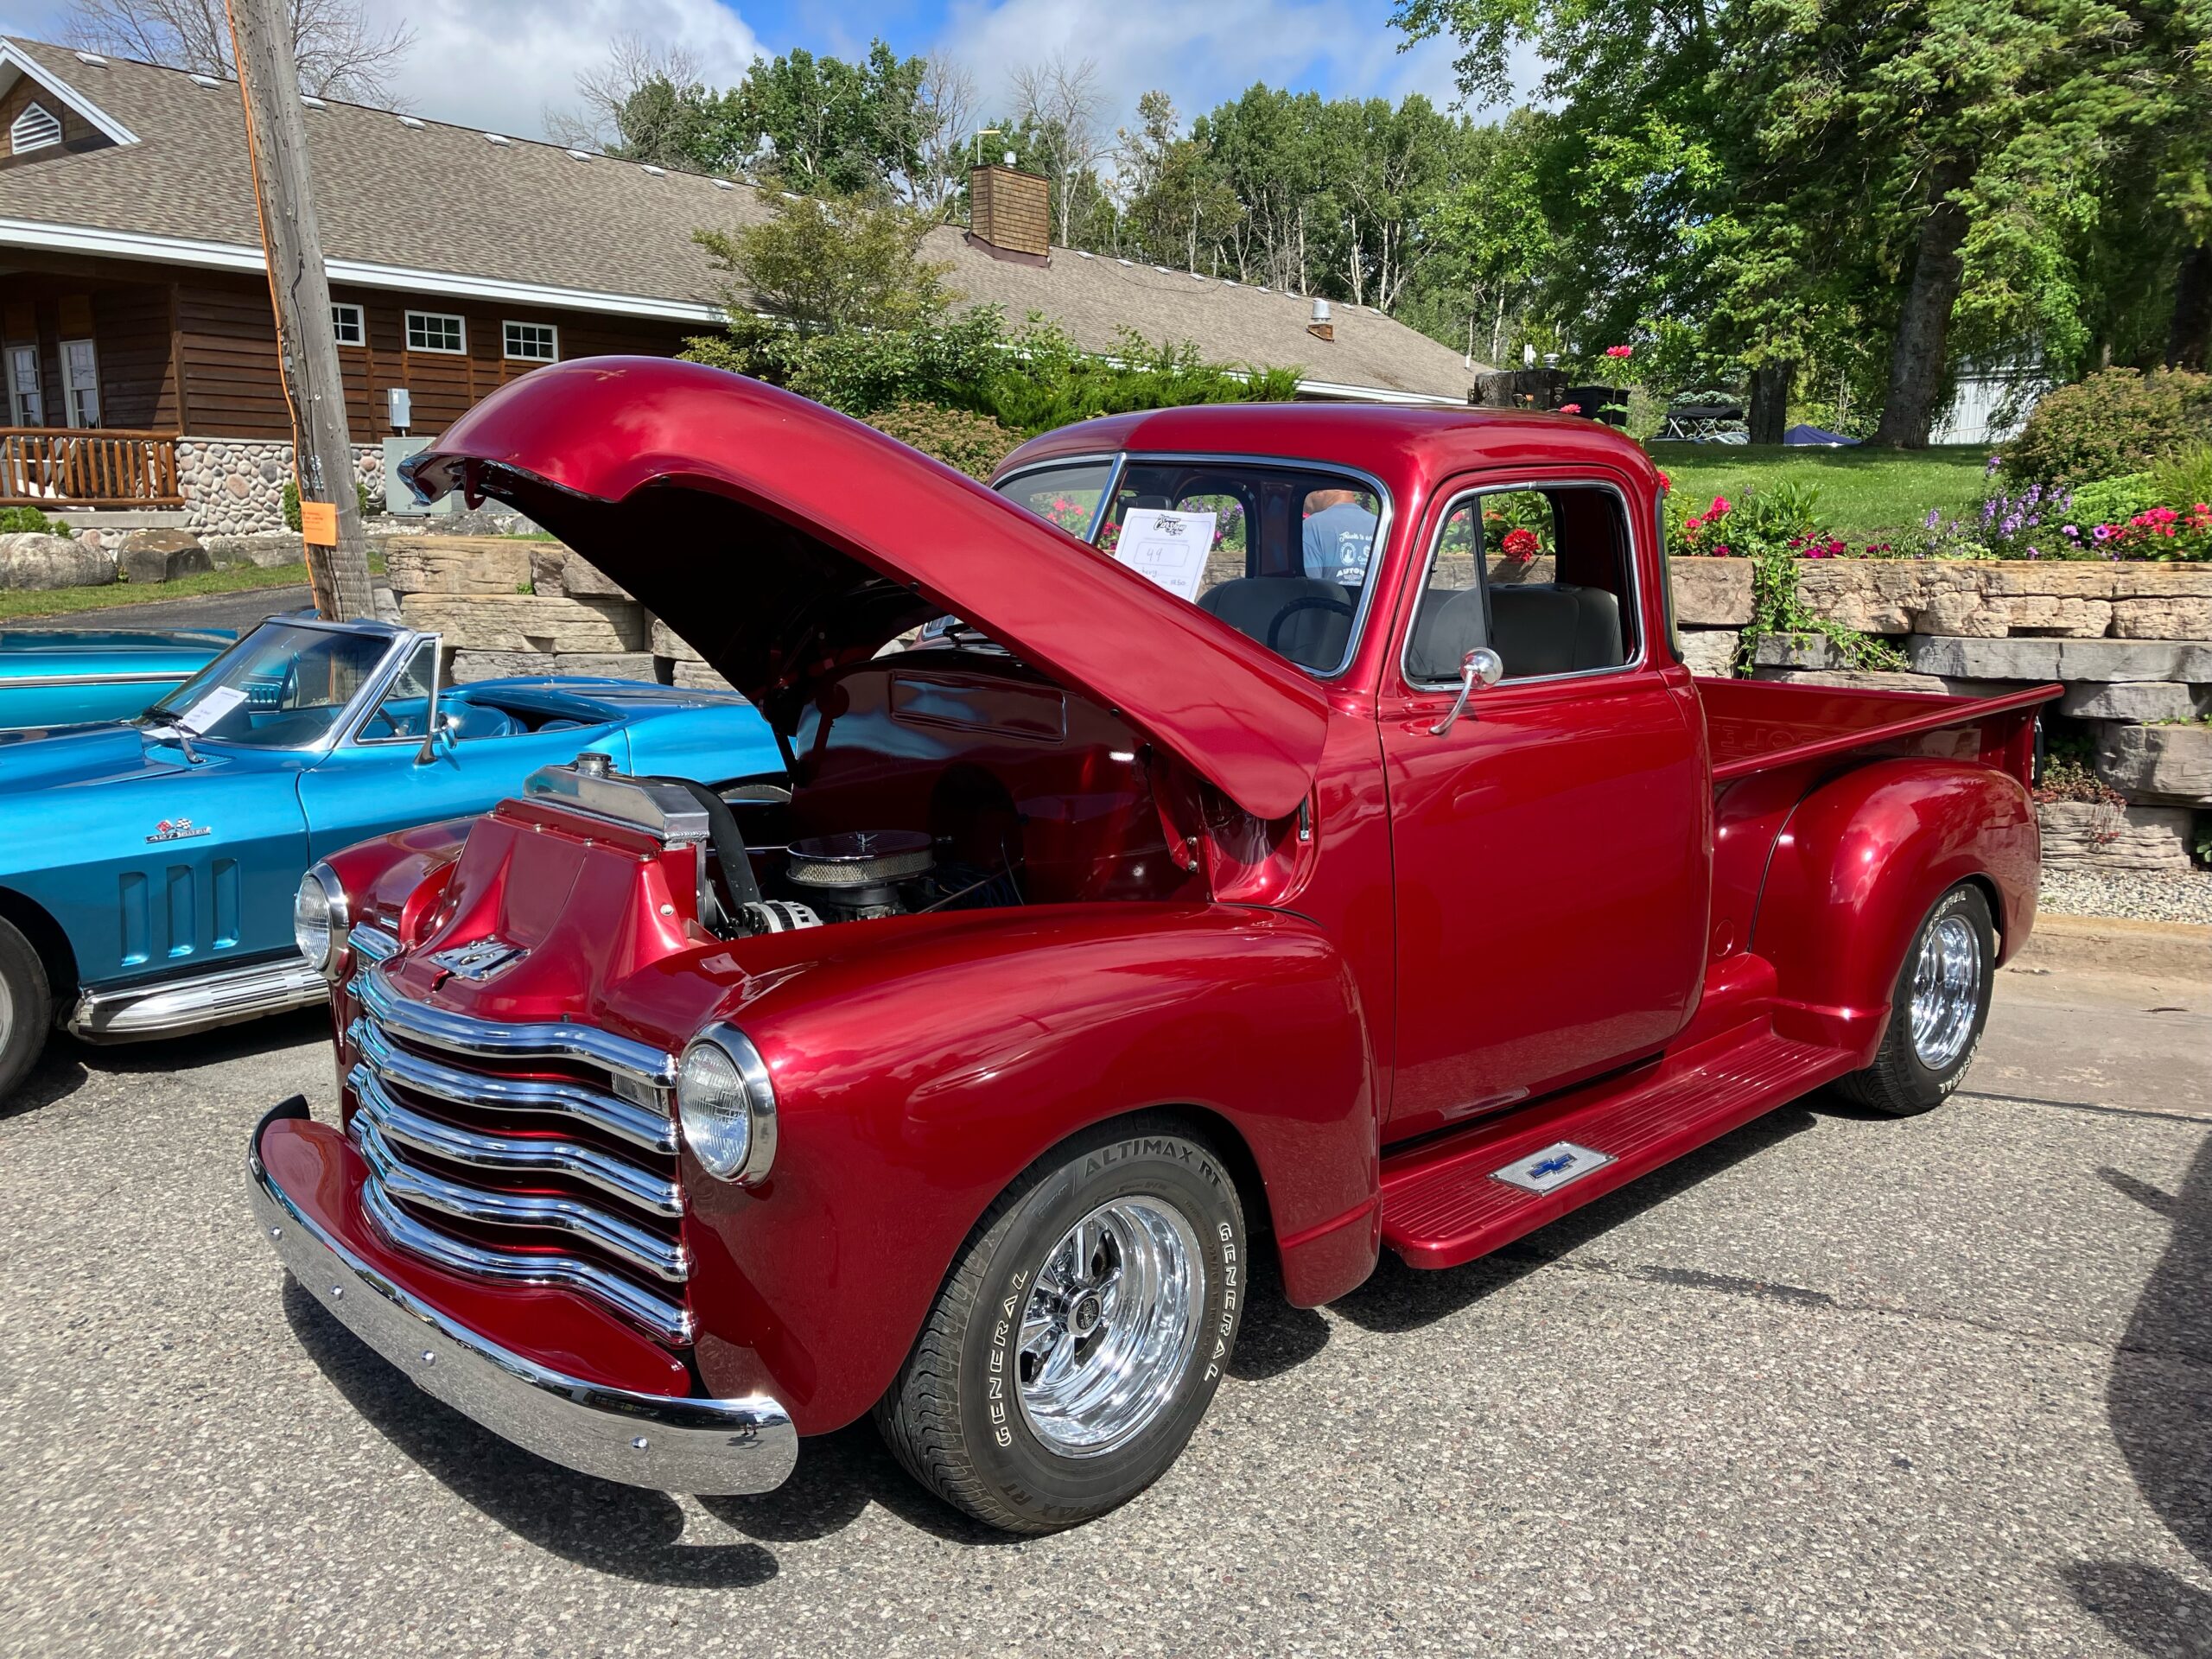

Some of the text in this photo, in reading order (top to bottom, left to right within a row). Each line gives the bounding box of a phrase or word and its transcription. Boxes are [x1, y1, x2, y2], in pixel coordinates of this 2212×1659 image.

[1920, 890, 1967, 950] GENERAL
[1939, 1033, 1981, 1094] GENERAL
[1083, 1139, 1223, 1188] ALTIMAX RT
[1204, 1222, 1236, 1382] GENERAL
[988, 1269, 1029, 1448] GENERAL
